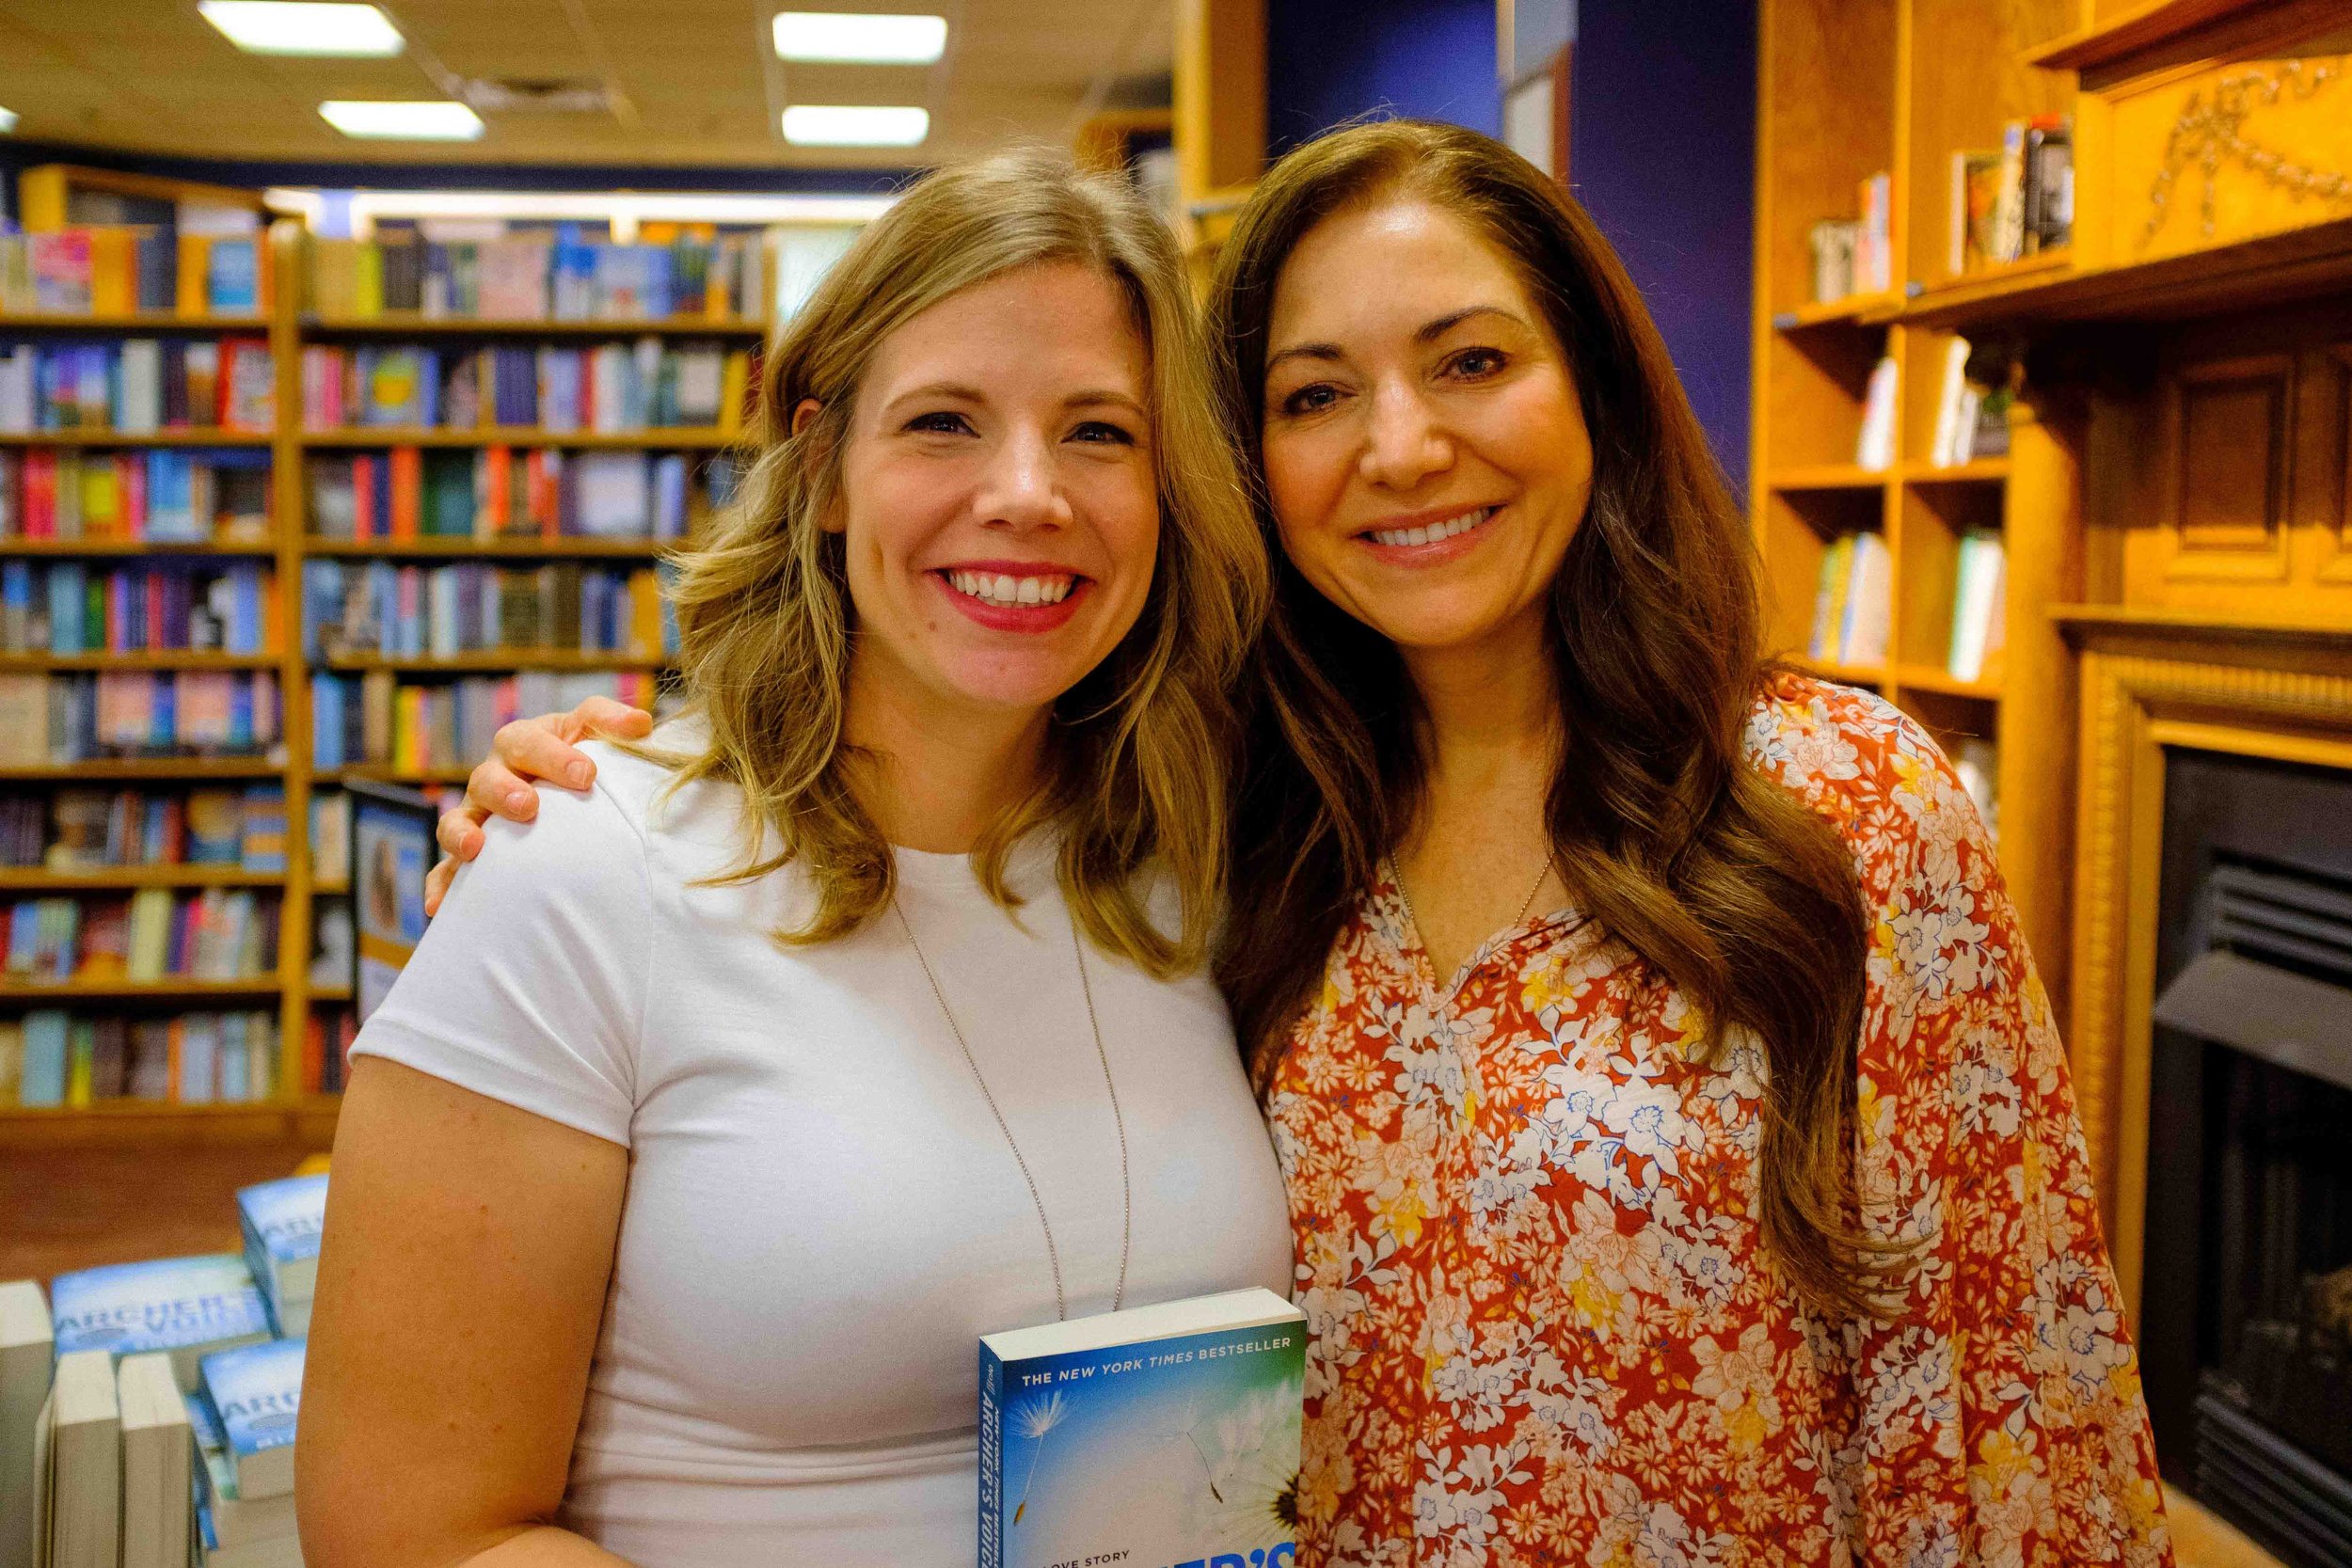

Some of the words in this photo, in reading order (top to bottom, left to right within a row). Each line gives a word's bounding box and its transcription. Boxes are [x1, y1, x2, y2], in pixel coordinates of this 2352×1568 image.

[1022, 1372, 1053, 1387] THE
[1058, 1367, 1096, 1382] NEW
[1102, 1358, 1144, 1375] YORK
[1149, 1351, 1194, 1368] TIMES
[1199, 1337, 1291, 1360] BESTSELLER
[982, 1390, 994, 1509] ARCHER'S
[981, 1512, 993, 1568] VOIC
[1085, 1549, 1130, 1567] STORY
